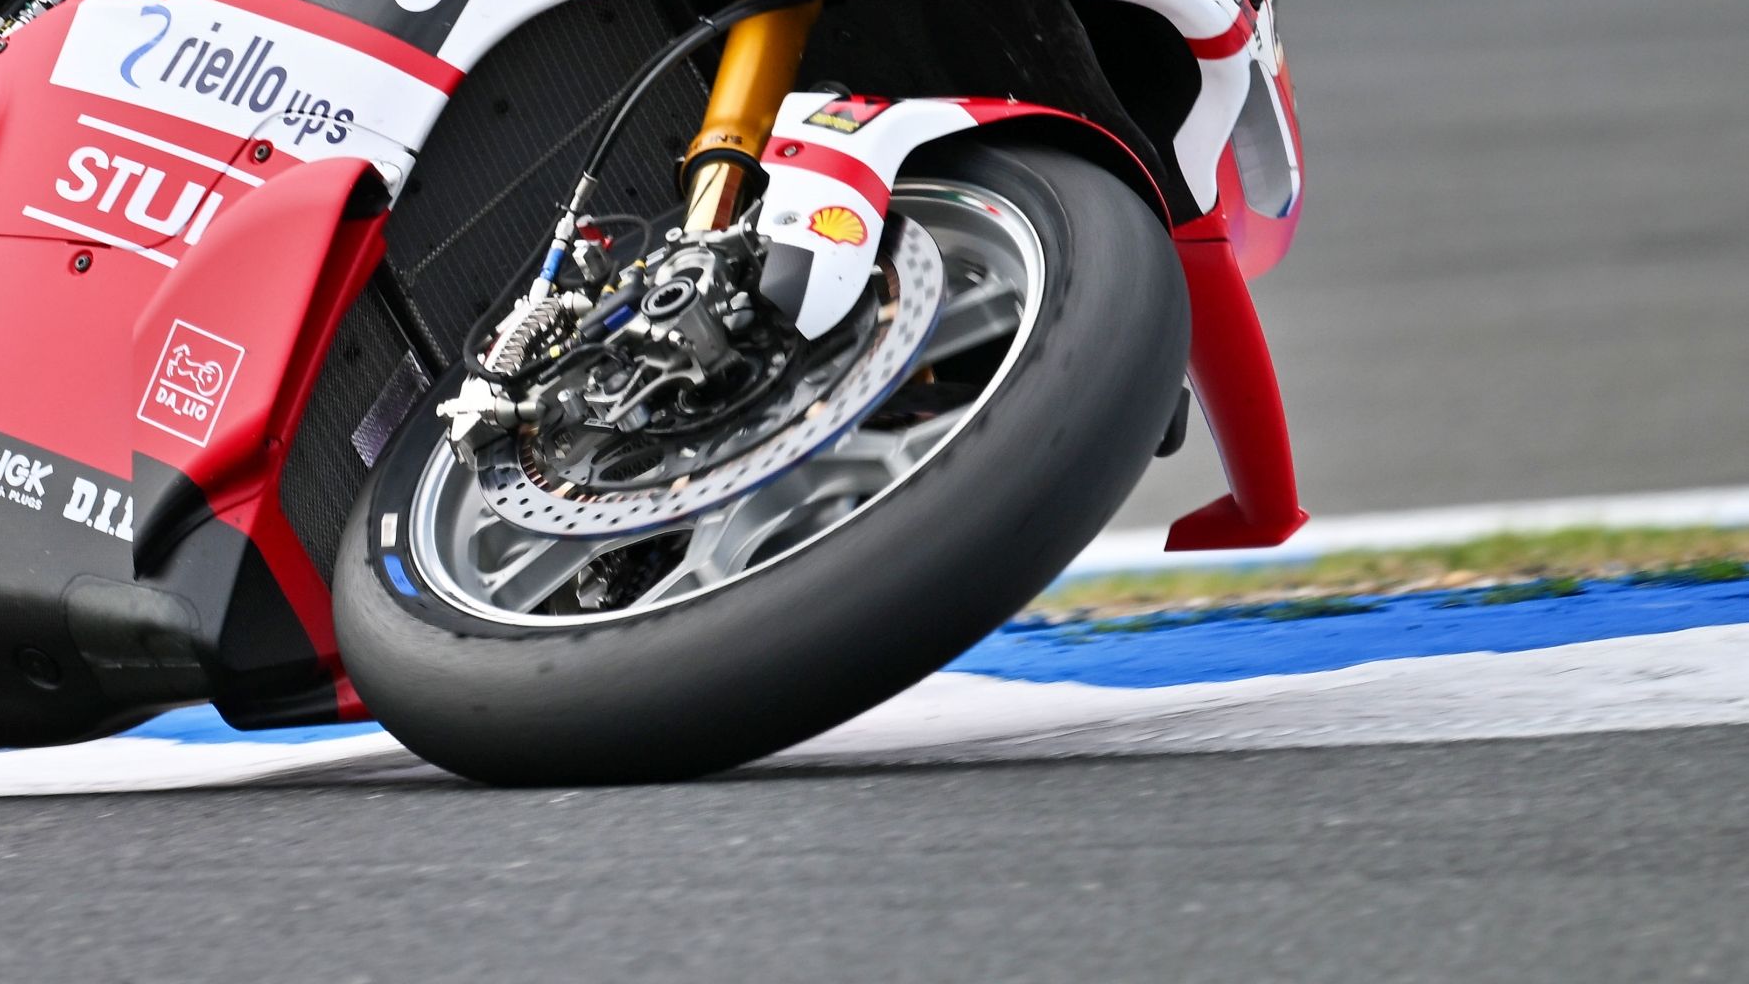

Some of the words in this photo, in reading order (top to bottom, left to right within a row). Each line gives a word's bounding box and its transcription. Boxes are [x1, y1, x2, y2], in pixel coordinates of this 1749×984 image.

[159, 21, 288, 113] riello
[282, 89, 355, 146] ups
[8, 489, 43, 511] PLUGS
